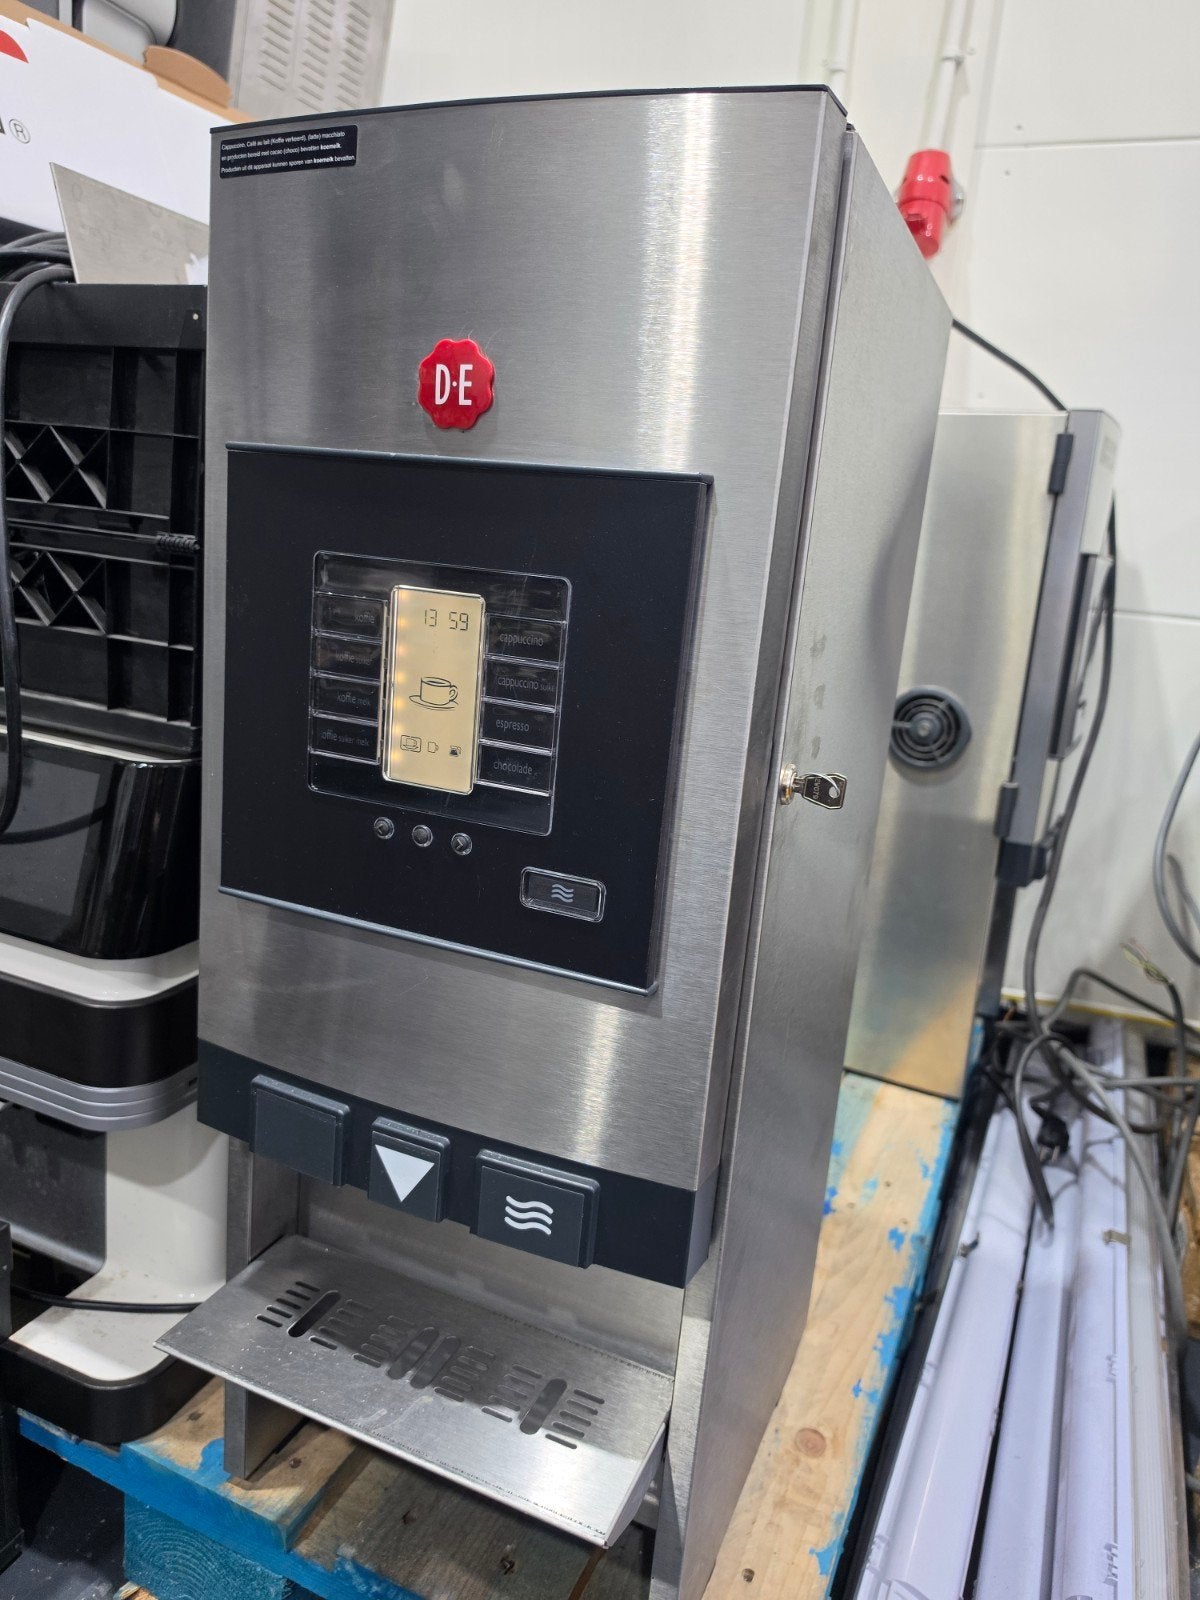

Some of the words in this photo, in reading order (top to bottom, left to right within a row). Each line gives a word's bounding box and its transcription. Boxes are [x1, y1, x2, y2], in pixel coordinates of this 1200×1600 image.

[449, 611, 469, 631] 59
[499, 633, 544, 647] cappuccino
[497, 676, 539, 690] cappuccino
[495, 719, 530, 732] espresso
[320, 728, 338, 742] offie
[493, 759, 533, 775] chocolade
